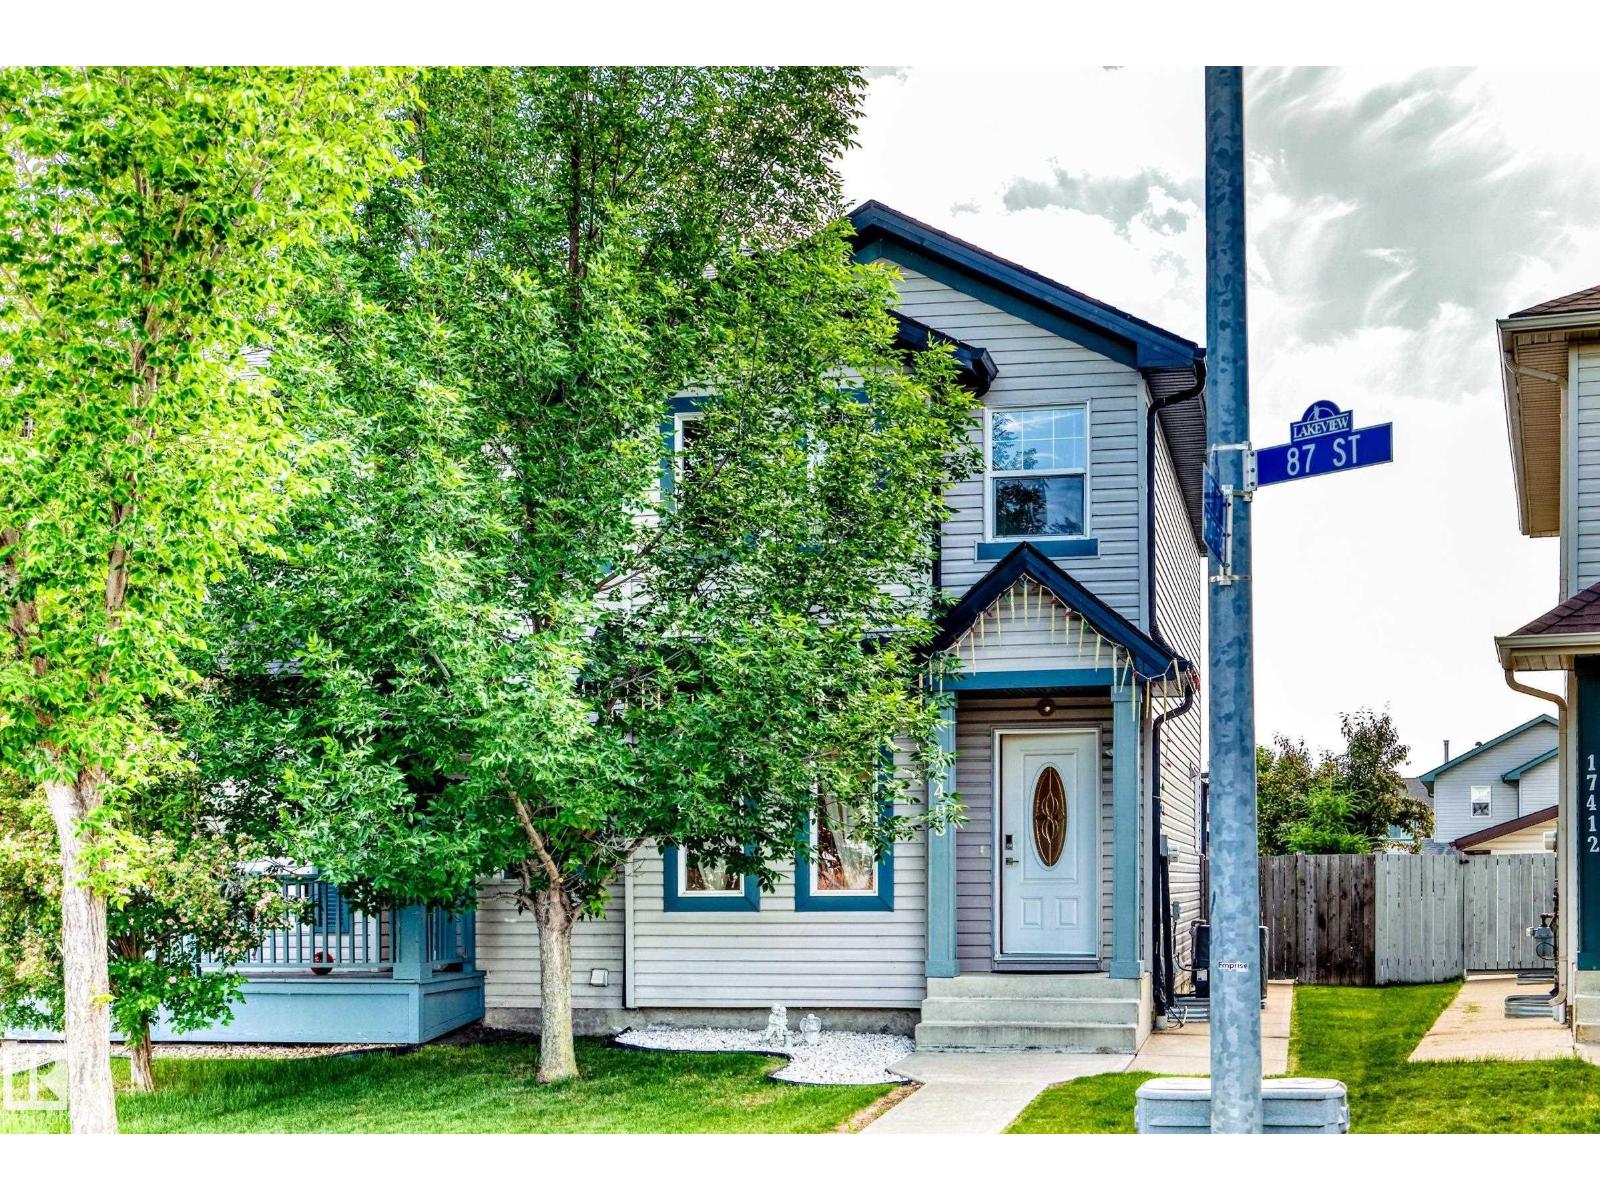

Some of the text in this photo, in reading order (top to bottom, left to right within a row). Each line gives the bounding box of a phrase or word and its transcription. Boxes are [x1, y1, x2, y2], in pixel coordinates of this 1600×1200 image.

[1293, 416, 1349, 439] LAKEVIEW
[1287, 434, 1361, 476] 87 ST
[1586, 753, 1600, 853] 17412
